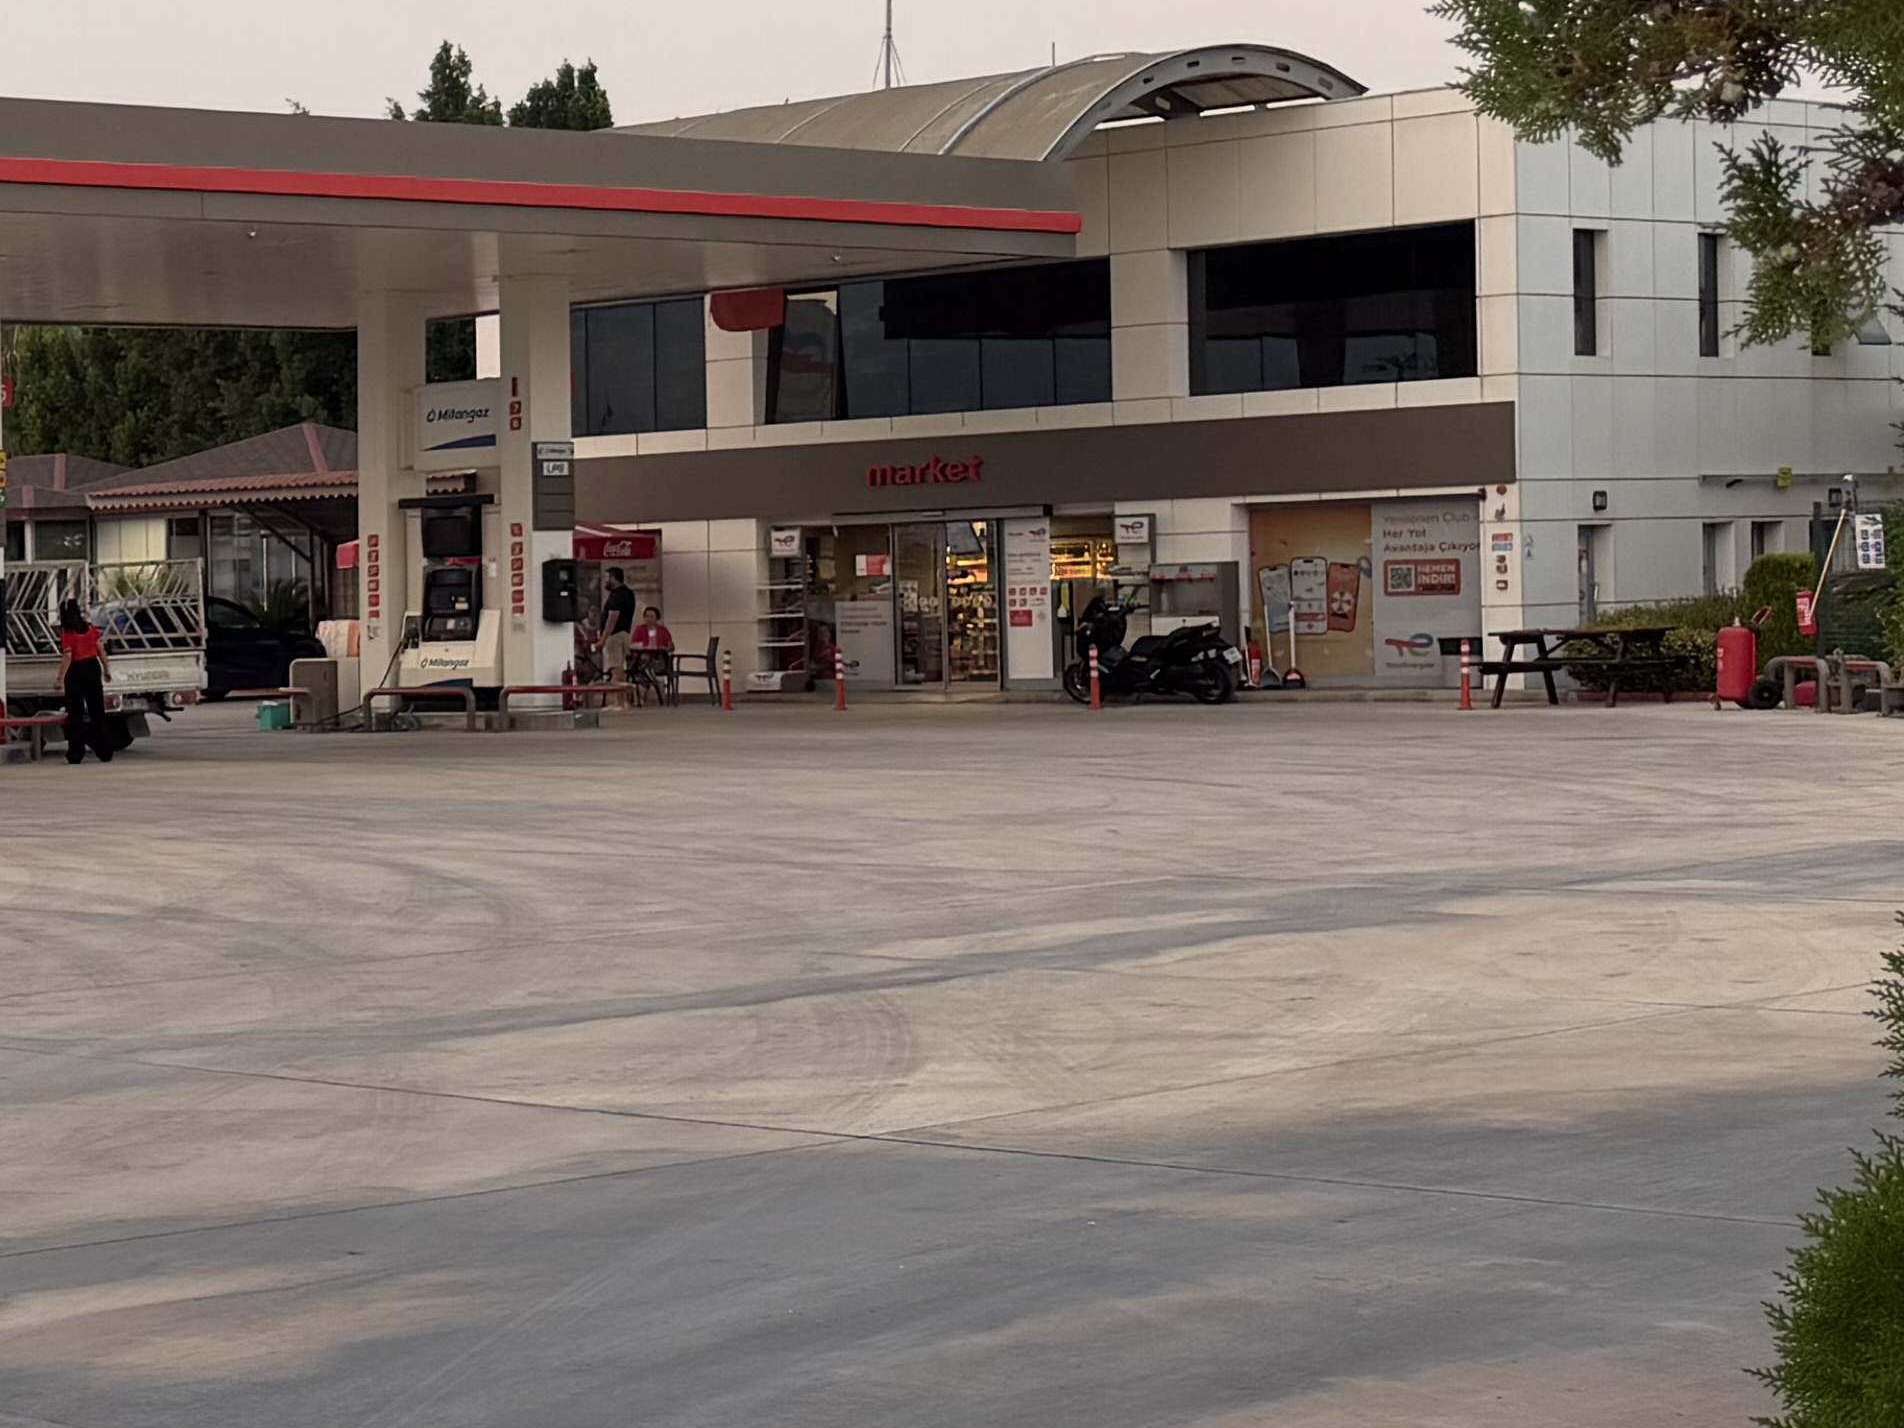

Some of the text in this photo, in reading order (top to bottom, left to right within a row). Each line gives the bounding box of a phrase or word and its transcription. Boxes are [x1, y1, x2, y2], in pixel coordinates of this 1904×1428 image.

[438, 408, 490, 424] Milangaz
[865, 454, 984, 488] market
[1383, 528, 1427, 539] Her Yol
